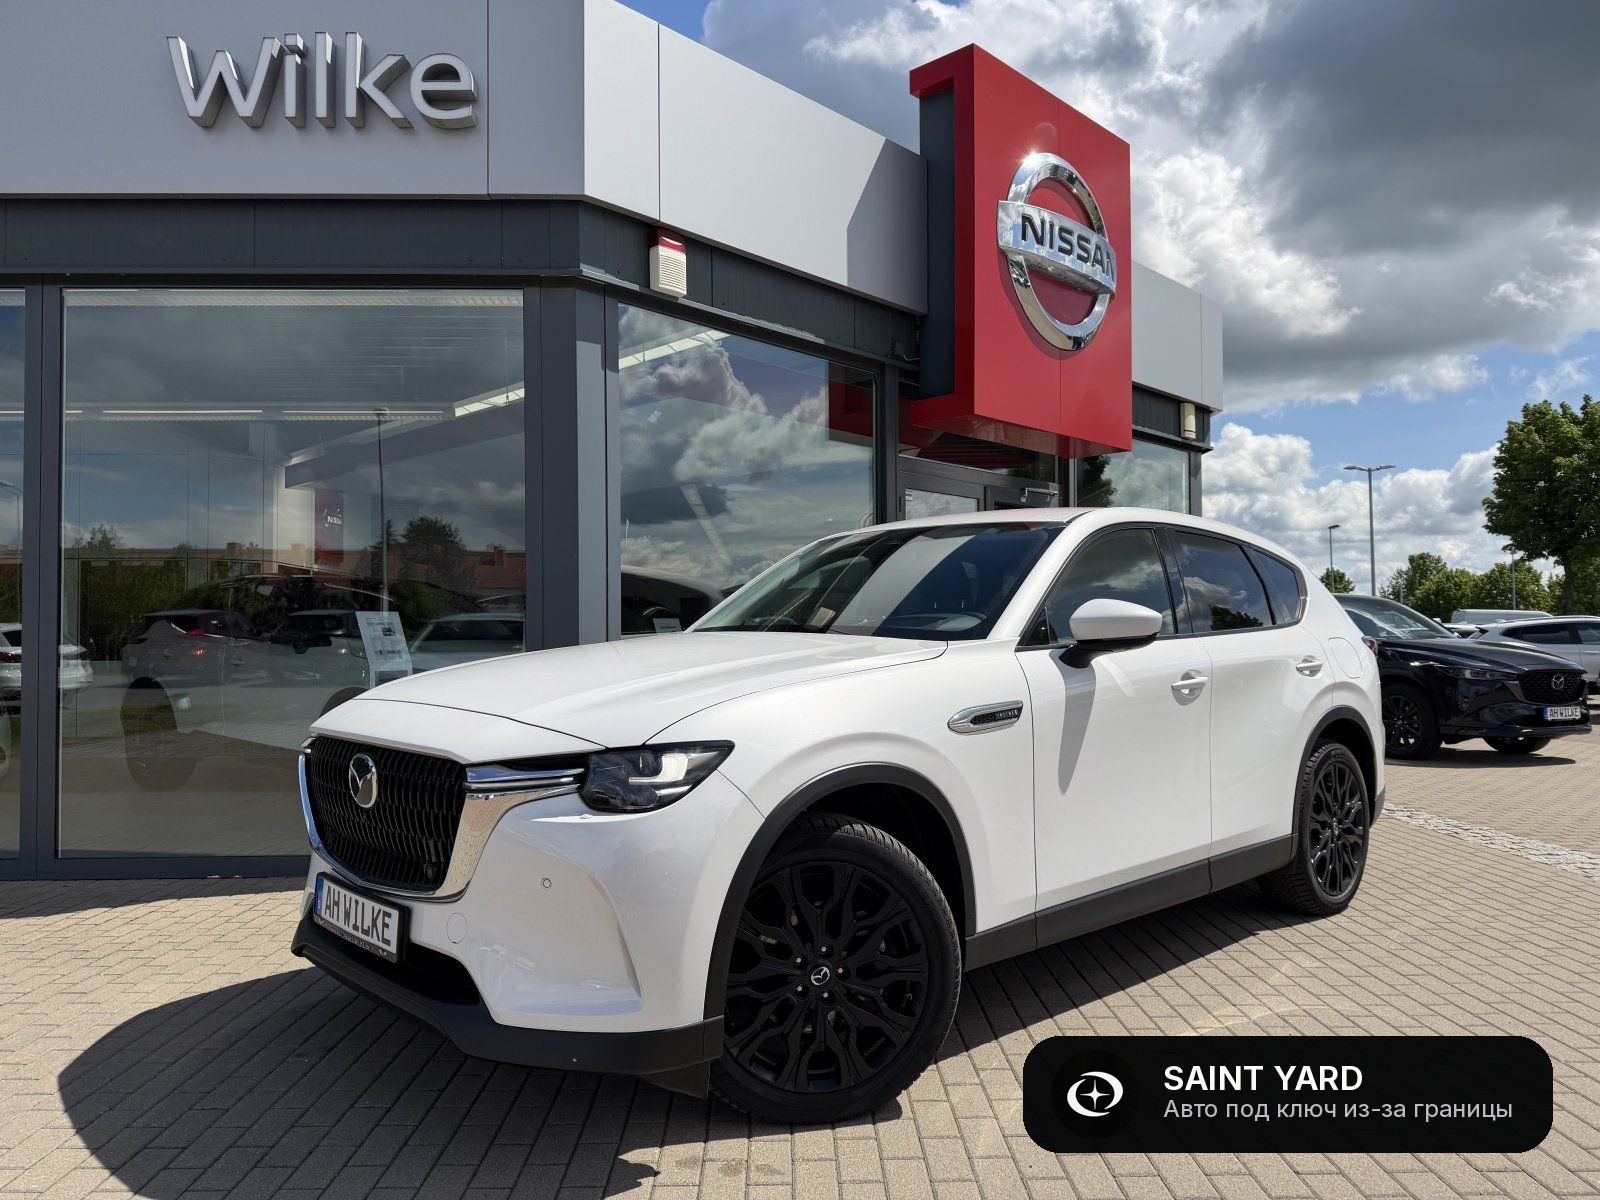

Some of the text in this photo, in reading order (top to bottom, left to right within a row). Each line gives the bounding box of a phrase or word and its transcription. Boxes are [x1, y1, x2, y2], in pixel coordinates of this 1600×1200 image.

[166, 31, 477, 128] Wilke
[1021, 214, 1116, 282] NISSAN
[1560, 707, 1579, 718] WILKE
[324, 885, 341, 922] AH
[343, 893, 392, 947] WILKE
